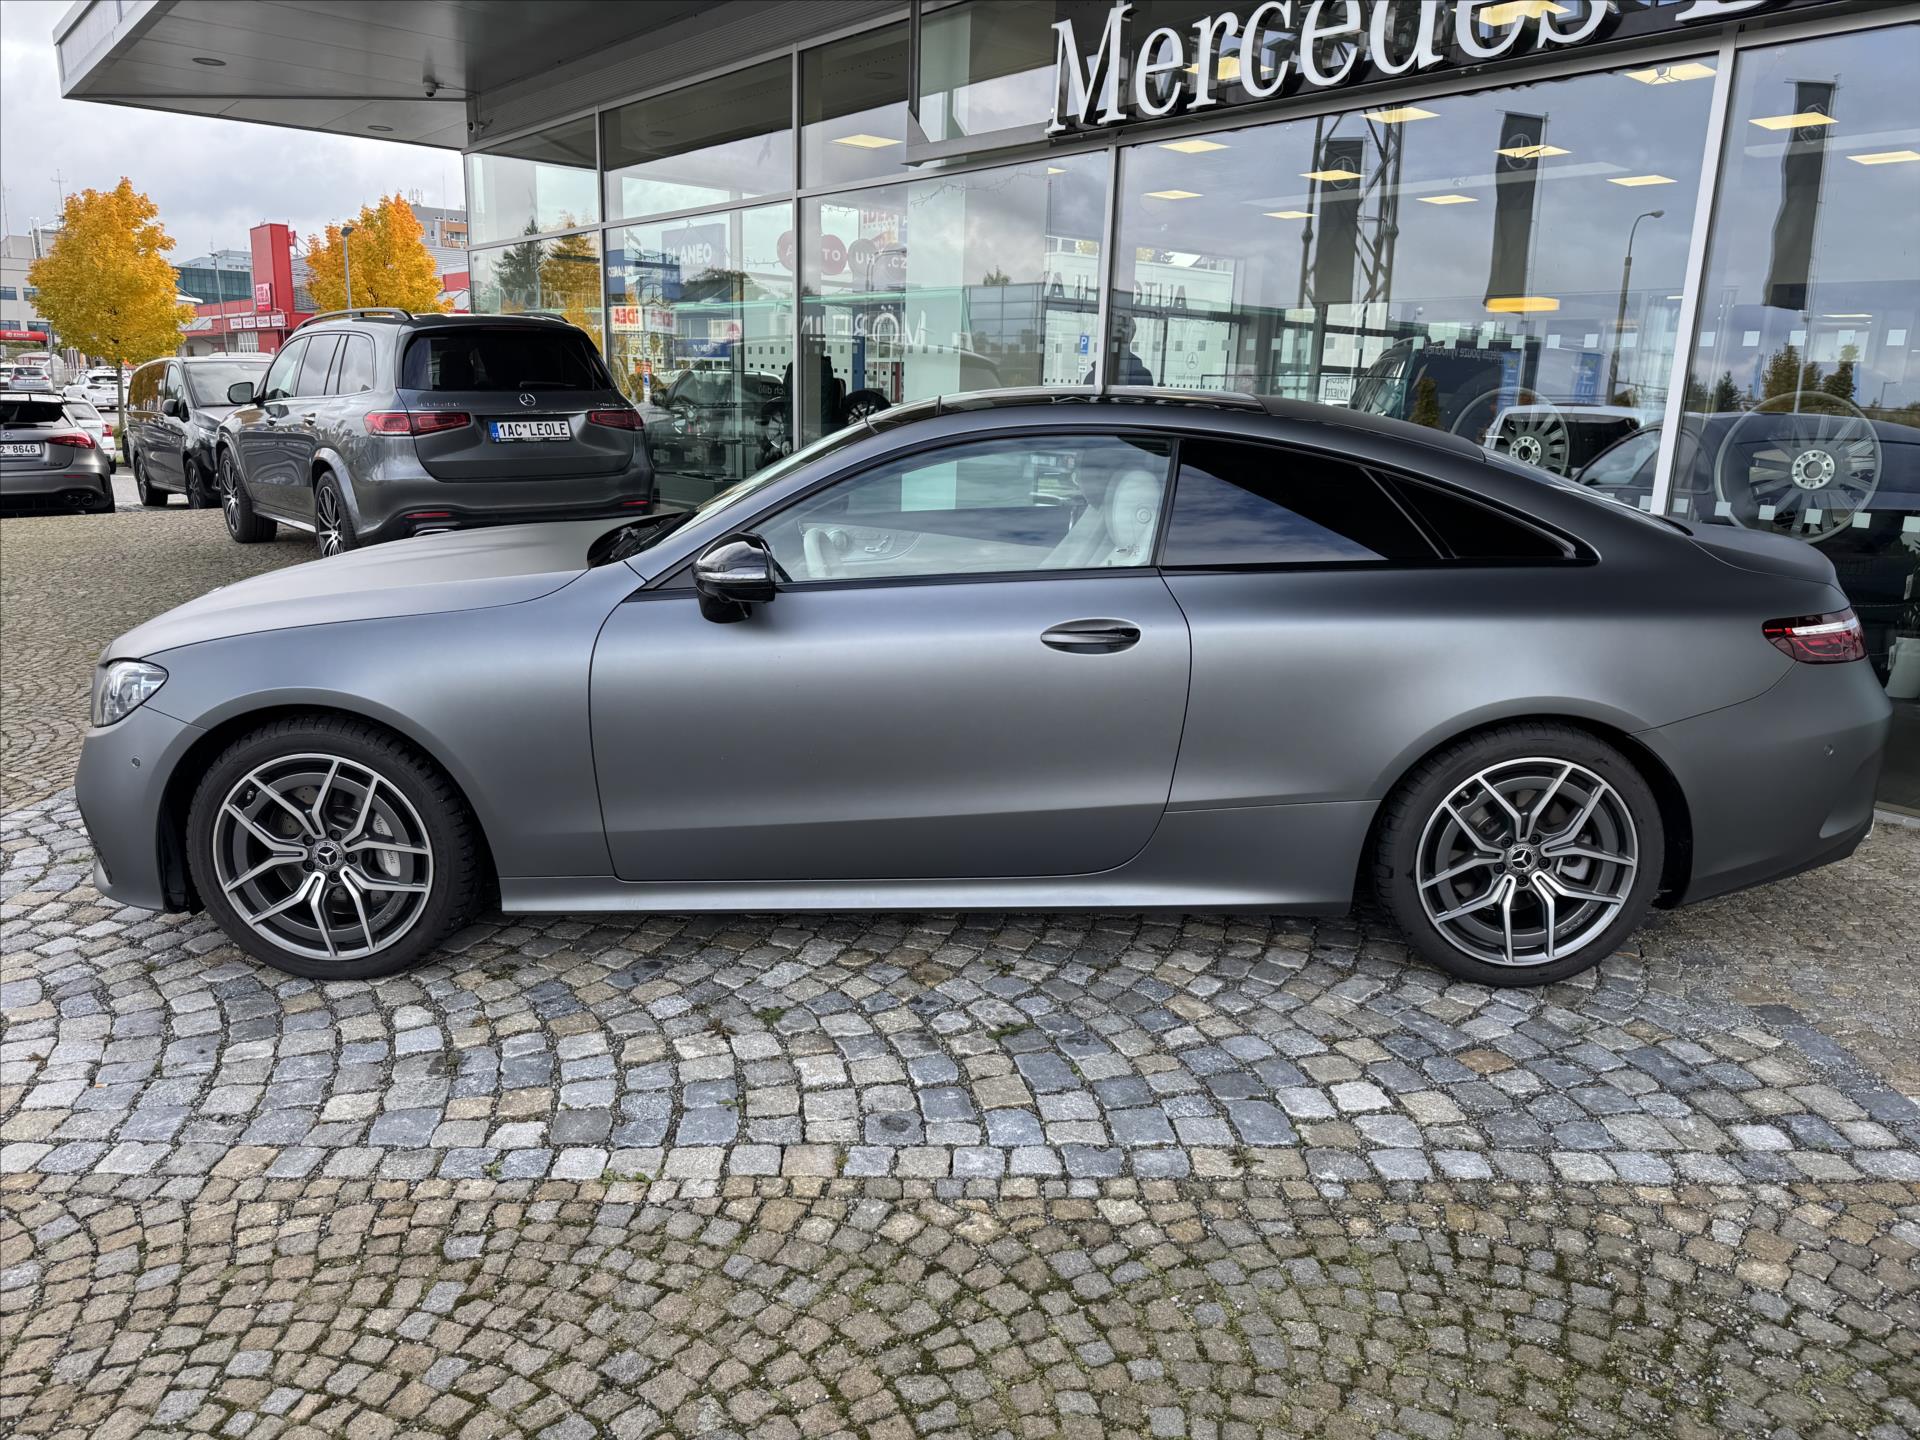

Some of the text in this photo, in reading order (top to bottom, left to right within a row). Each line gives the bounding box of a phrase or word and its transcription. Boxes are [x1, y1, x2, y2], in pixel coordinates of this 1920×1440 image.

[665, 242, 712, 266] PLANEO
[785, 244, 841, 262] ATO
[500, 423, 568, 437] 1AC LEOLE
[12, 445, 36, 453] 8646
